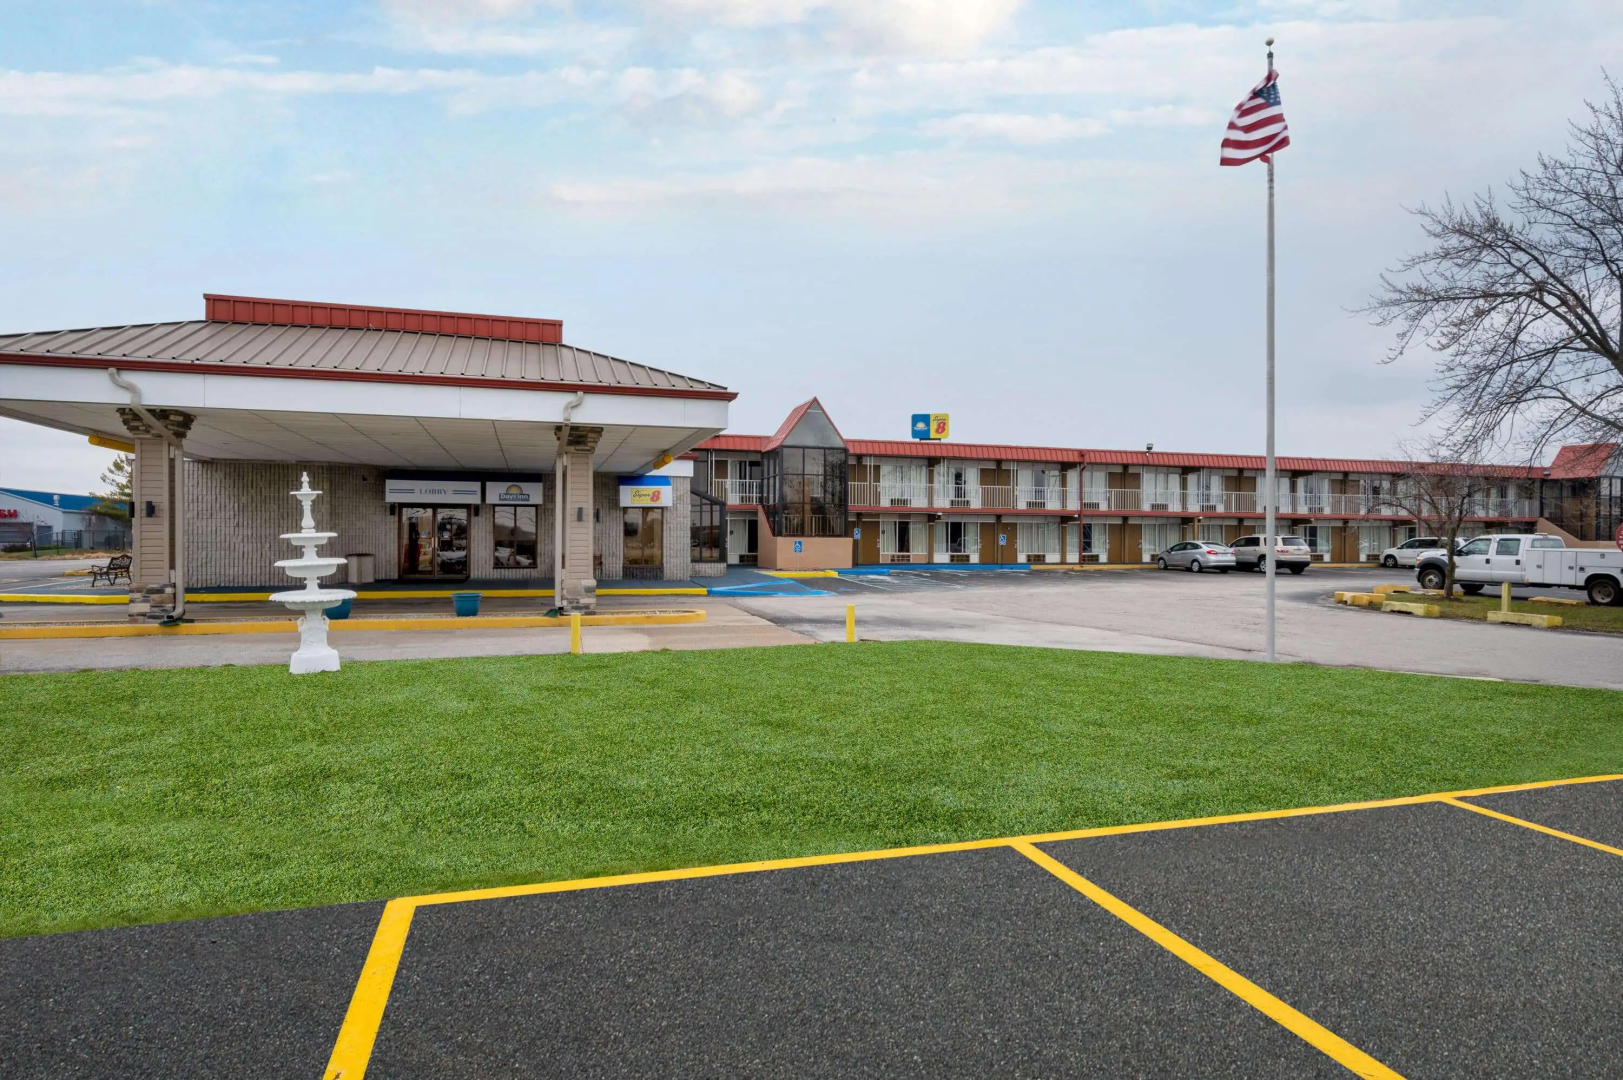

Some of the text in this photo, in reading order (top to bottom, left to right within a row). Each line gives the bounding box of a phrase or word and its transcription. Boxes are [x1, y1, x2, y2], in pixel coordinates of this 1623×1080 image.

[935, 421, 946, 434] 8
[633, 490, 660, 502] Super 8
